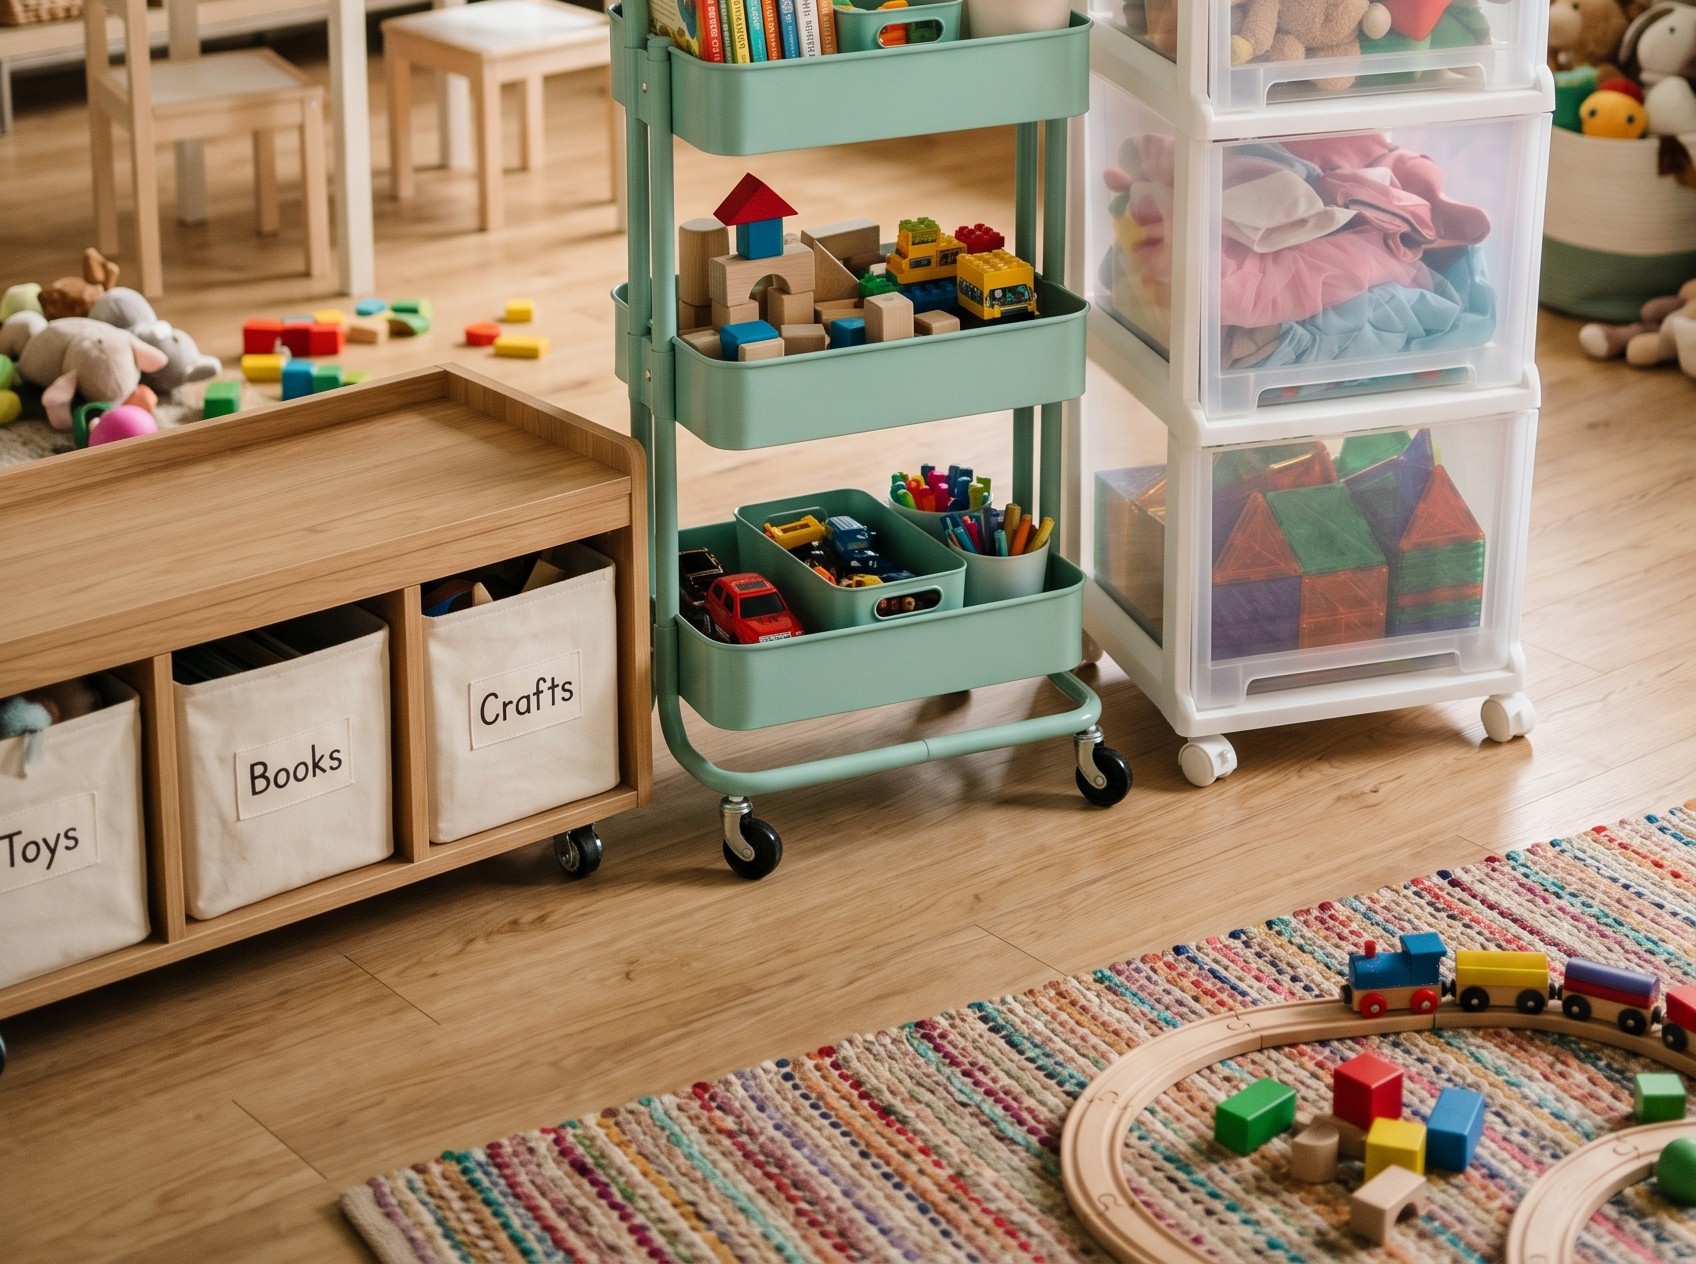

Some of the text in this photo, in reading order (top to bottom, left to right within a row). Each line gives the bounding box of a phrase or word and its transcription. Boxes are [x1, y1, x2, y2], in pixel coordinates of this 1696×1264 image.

[480, 676, 574, 726] Crafts
[249, 744, 343, 797] Books
[0, 827, 79, 871] Toys
